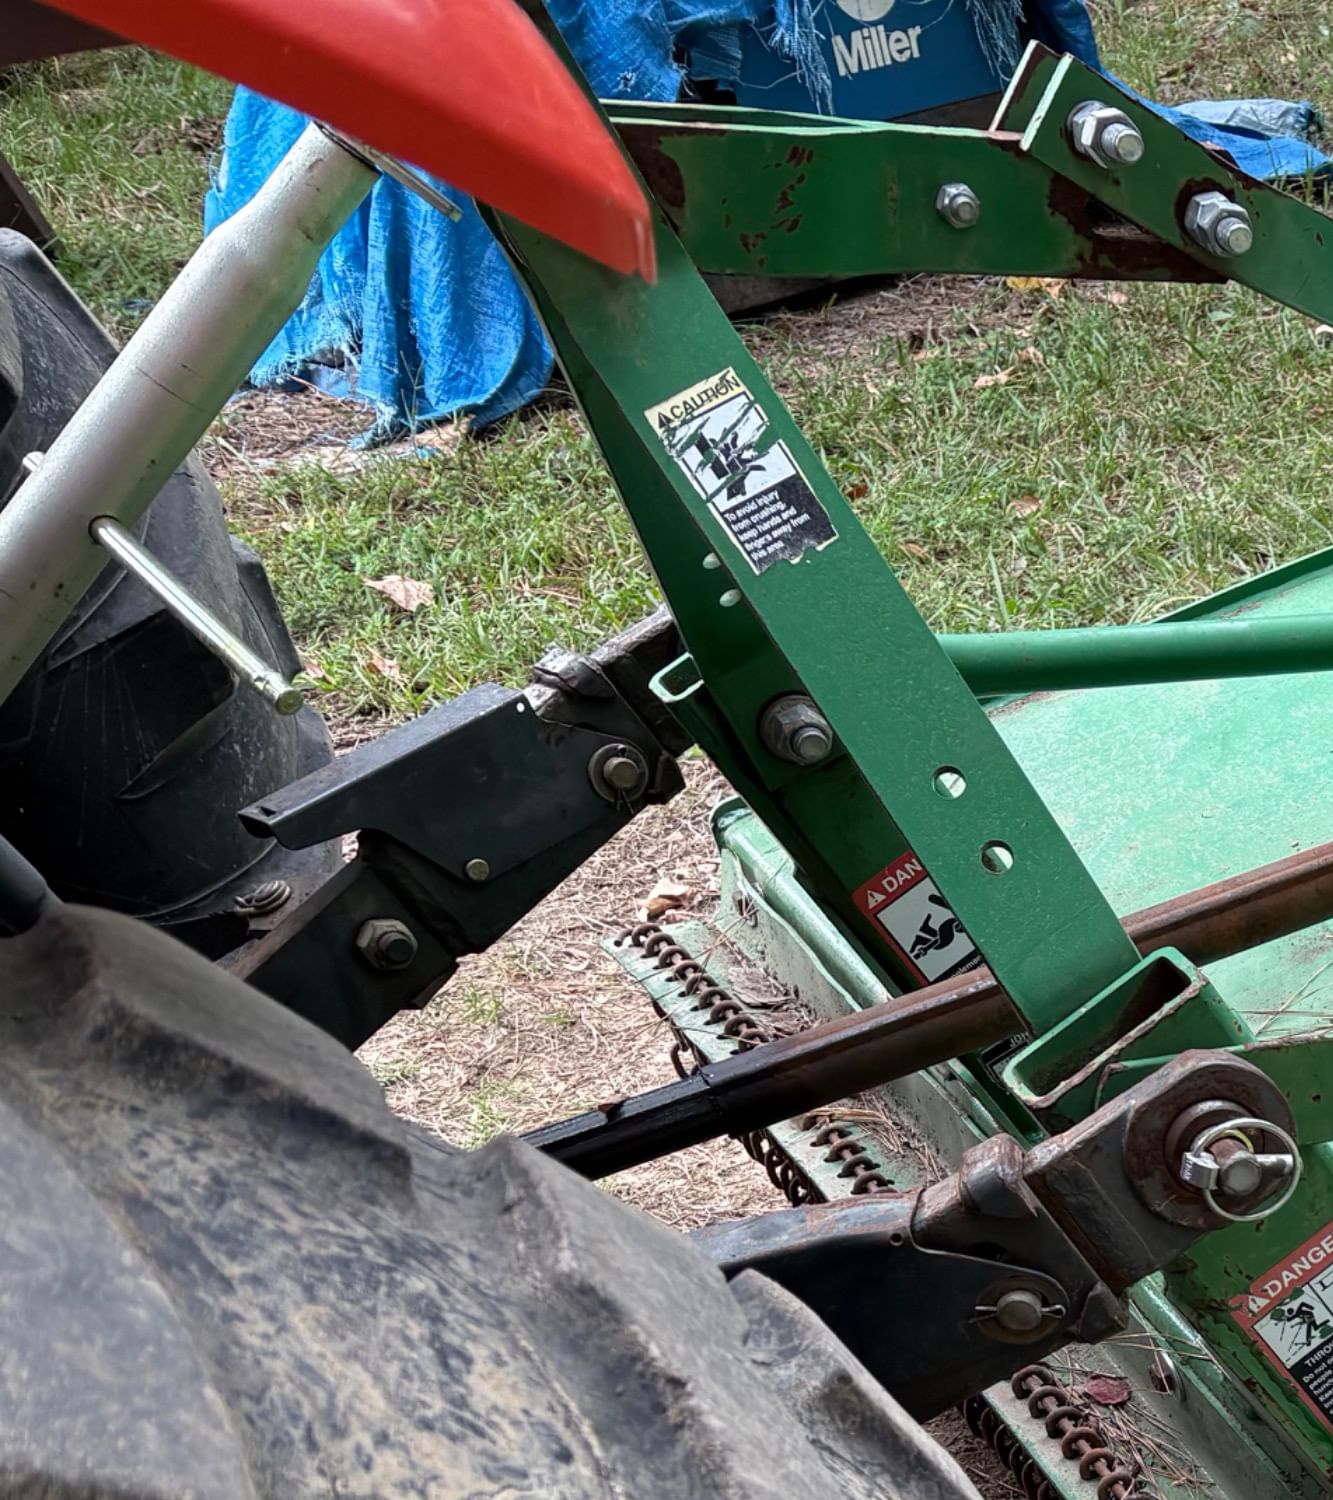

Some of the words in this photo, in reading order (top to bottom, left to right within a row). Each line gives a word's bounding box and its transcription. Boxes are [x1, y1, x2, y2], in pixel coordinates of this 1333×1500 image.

[832, 24, 922, 77] Miller
[670, 375, 740, 419] CAUTION
[724, 513, 736, 522] To
[735, 500, 758, 517] avoid
[755, 490, 779, 506] injury
[737, 528, 758, 541] keep
[756, 515, 782, 532] hands
[781, 506, 796, 520] and
[731, 518, 751, 532] from
[744, 534, 772, 551] fingers
[771, 523, 792, 538] away
[790, 513, 810, 527] from
[881, 858, 922, 893] DAN
[1302, 1373, 1314, 1383] Do
[1314, 1362, 1327, 1374] not
